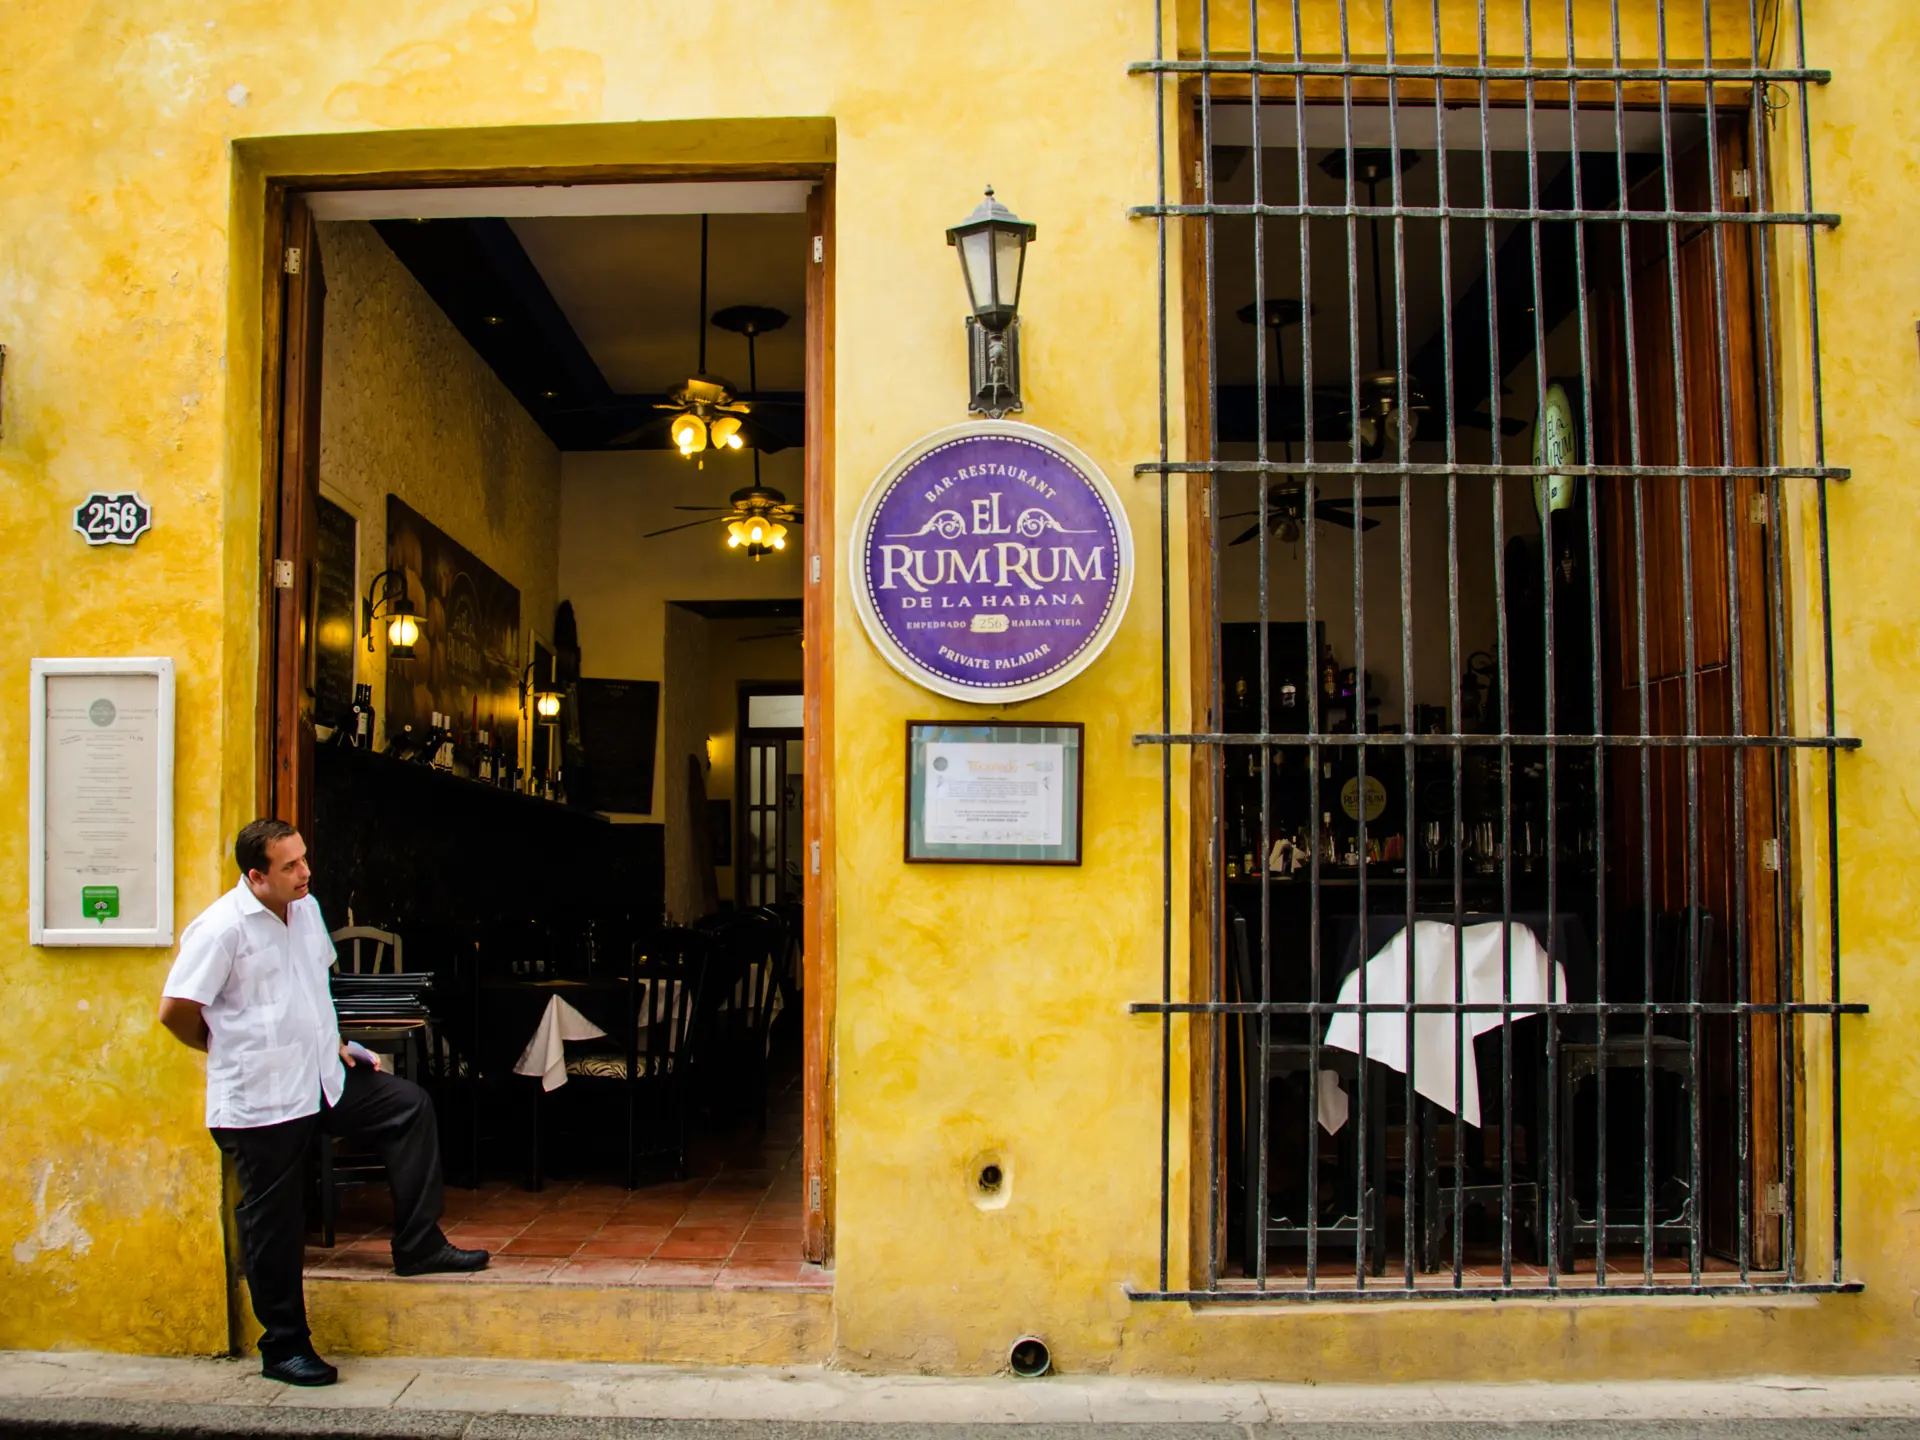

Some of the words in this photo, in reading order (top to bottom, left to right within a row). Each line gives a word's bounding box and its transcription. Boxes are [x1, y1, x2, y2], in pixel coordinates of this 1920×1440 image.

[924, 463, 1056, 502] BAR-RESTAURANT
[88, 502, 138, 533] 256
[971, 492, 1011, 534] EL
[902, 596, 932, 609] DE
[941, 596, 972, 608] LA
[982, 594, 1085, 607] HABANA
[906, 621, 967, 630] EMPEDRADO
[980, 617, 1002, 629] 256
[1011, 619, 1051, 628] HABANA
[1055, 618, 1082, 627] VIEJA
[938, 645, 990, 669] PRIVATE
[995, 643, 1051, 669] PALADAR
